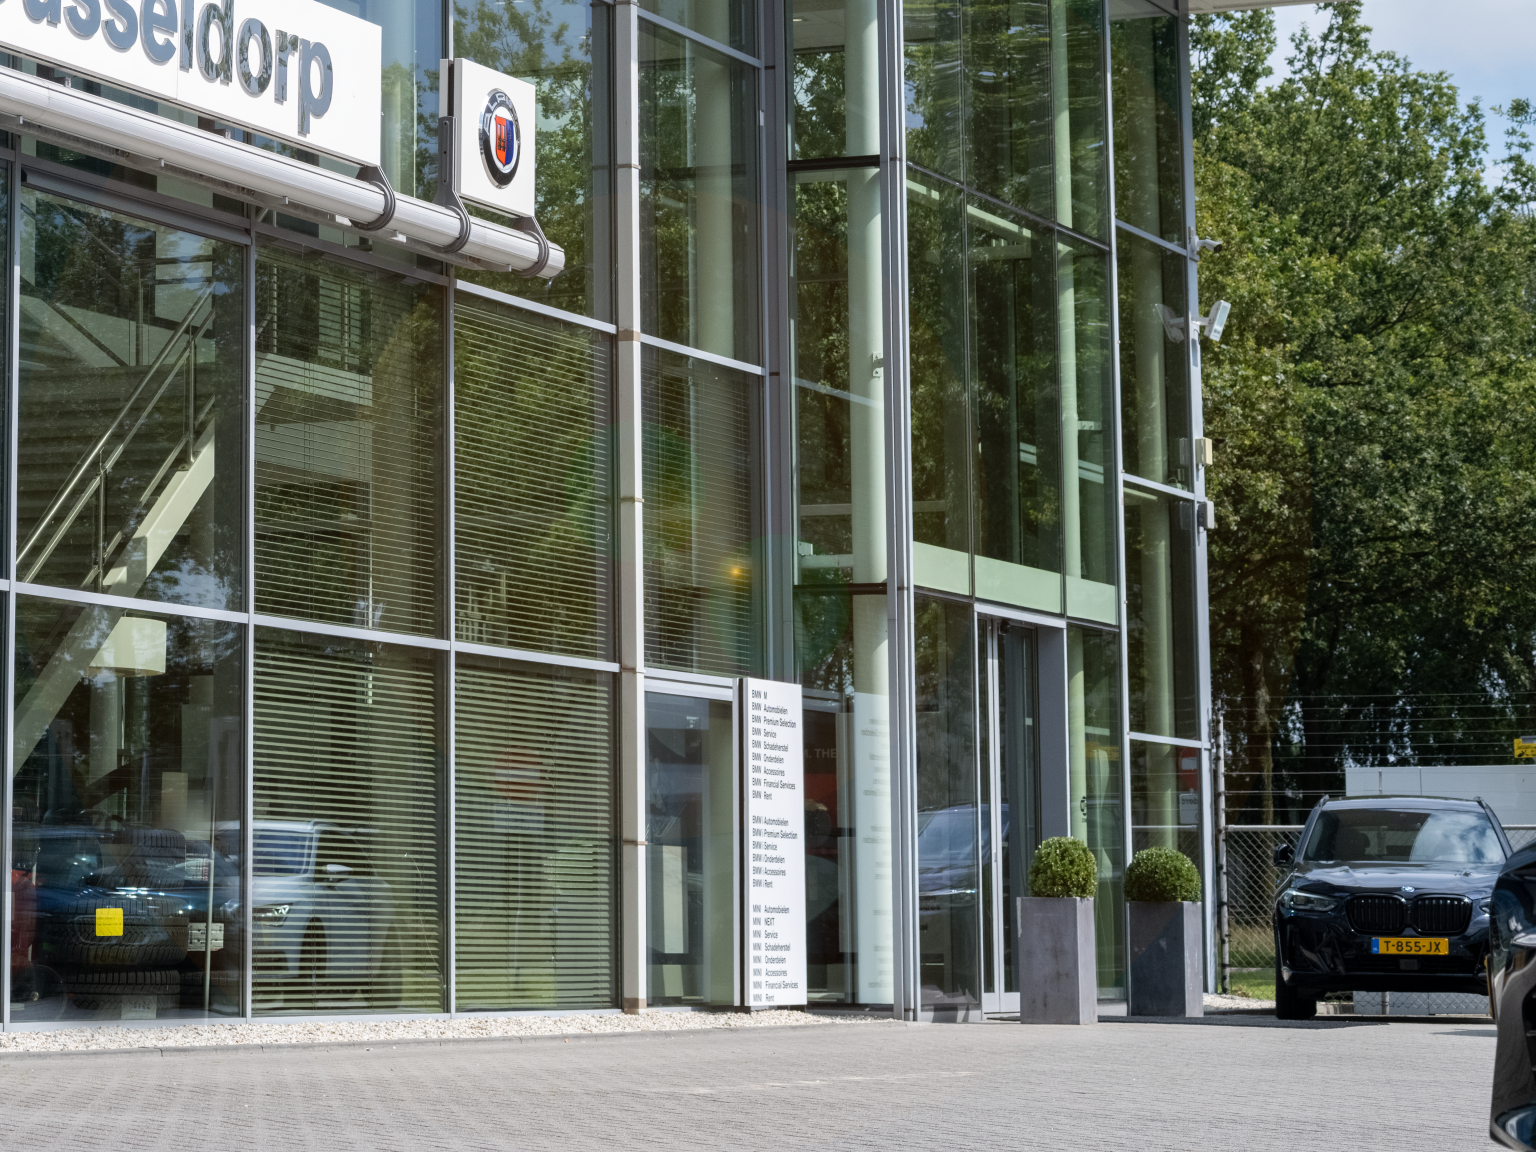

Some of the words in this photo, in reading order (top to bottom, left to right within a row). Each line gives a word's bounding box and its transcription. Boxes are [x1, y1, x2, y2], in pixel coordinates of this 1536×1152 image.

[752, 690, 762, 699] BMW
[764, 691, 767, 699] M
[752, 702, 762, 711] BMW
[764, 704, 788, 715] Automobielen
[752, 715, 762, 723] BMW
[764, 717, 779, 726] Premium
[780, 718, 796, 728] Selection
[752, 727, 762, 736] BMW
[764, 729, 776, 738] Service
[752, 740, 762, 748] BMW
[764, 741, 788, 752] Schadeherstel
[752, 753, 762, 761] BMW
[764, 754, 784, 764] Onderdelen
[752, 765, 762, 773] BMW
[764, 766, 785, 776] Accessoires
[752, 778, 762, 786] BMW
[764, 779, 779, 788] Financial
[780, 780, 796, 790] Services
[752, 790, 762, 799] BMW
[764, 791, 772, 800] Rent
[764, 817, 788, 826] Automobielen
[764, 829, 780, 838] Premium
[780, 830, 798, 839] Selection
[764, 842, 777, 850] Service
[764, 854, 785, 863] Onderdelen
[764, 867, 786, 876] Accessoires
[764, 880, 773, 888] Rent
[1384, 941, 1441, 952] T-855-JX
[766, 981, 782, 989] Financial
